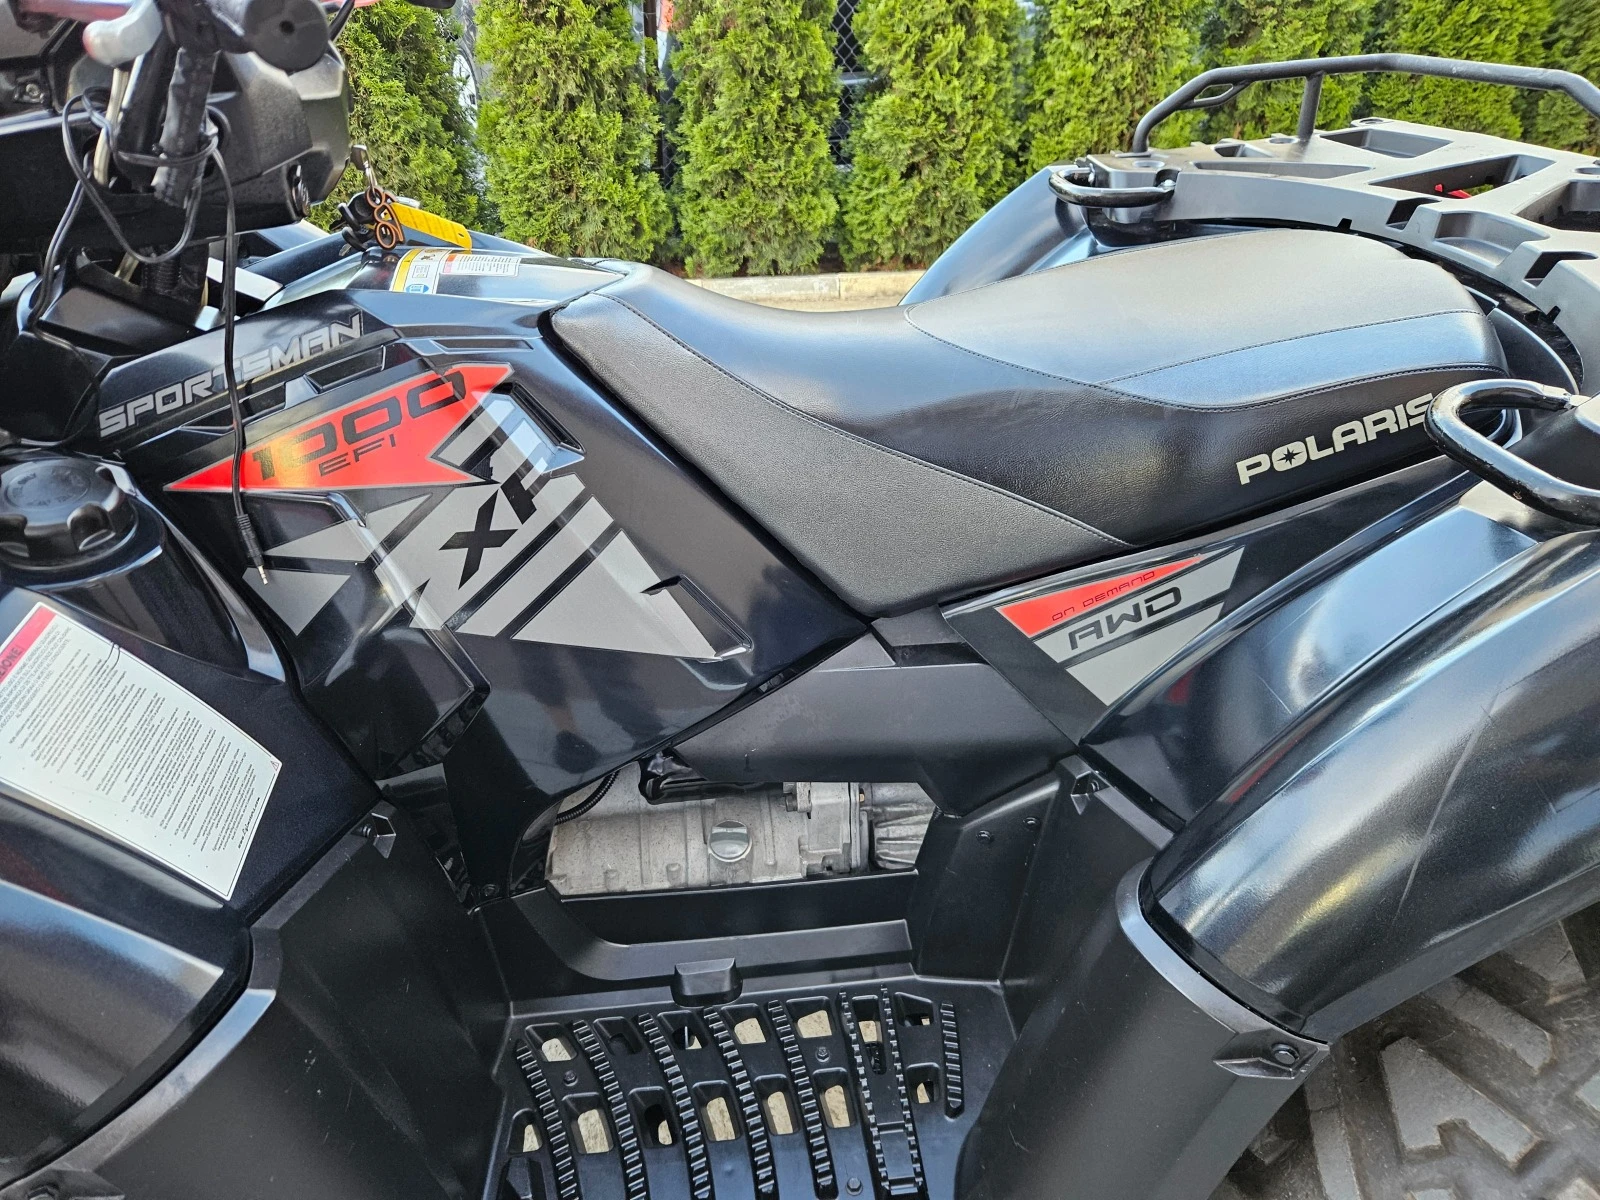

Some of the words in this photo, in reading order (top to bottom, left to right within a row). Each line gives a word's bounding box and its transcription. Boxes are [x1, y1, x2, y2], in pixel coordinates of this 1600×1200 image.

[98, 313, 363, 438] SPORTSMAN
[252, 370, 467, 481] 1000
[318, 434, 396, 477] EFI
[1235, 392, 1434, 485] POLARIS
[1051, 605, 1075, 622] ON
[1082, 570, 1156, 608] DEMAND
[1067, 586, 1182, 651] AWD
